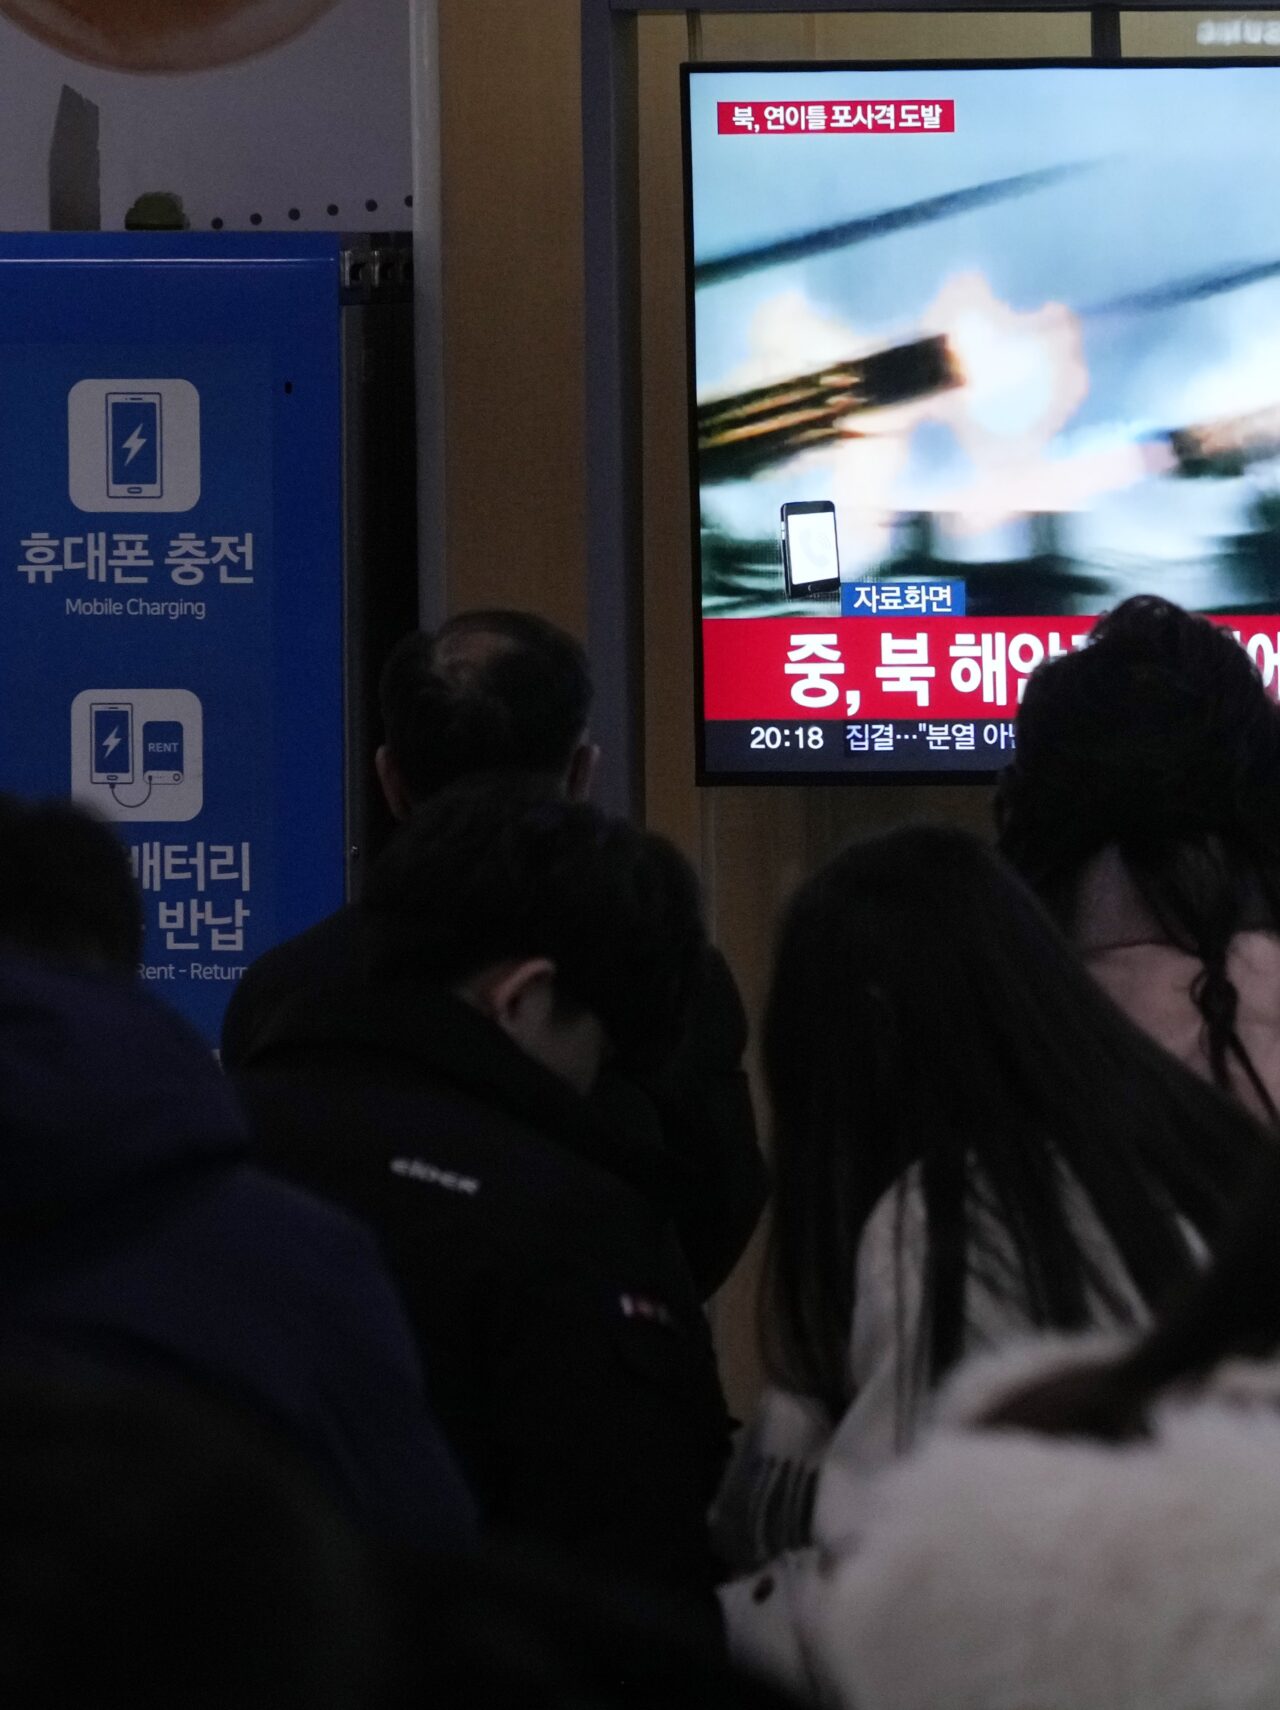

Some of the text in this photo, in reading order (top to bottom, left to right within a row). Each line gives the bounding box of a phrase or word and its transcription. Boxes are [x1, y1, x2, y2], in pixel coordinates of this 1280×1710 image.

[732, 104, 943, 133] 북, 연이틀 포사격 도발
[17, 532, 254, 585] 휴대폰 충전
[65, 598, 206, 620] Mobile Charging
[853, 584, 953, 614] 자료화면
[783, 632, 861, 717] 중,
[875, 631, 936, 707] 북
[949, 630, 1090, 706] 해안
[148, 742, 179, 753] RENT
[750, 726, 824, 750] 20:18
[158, 899, 250, 951] 반납
